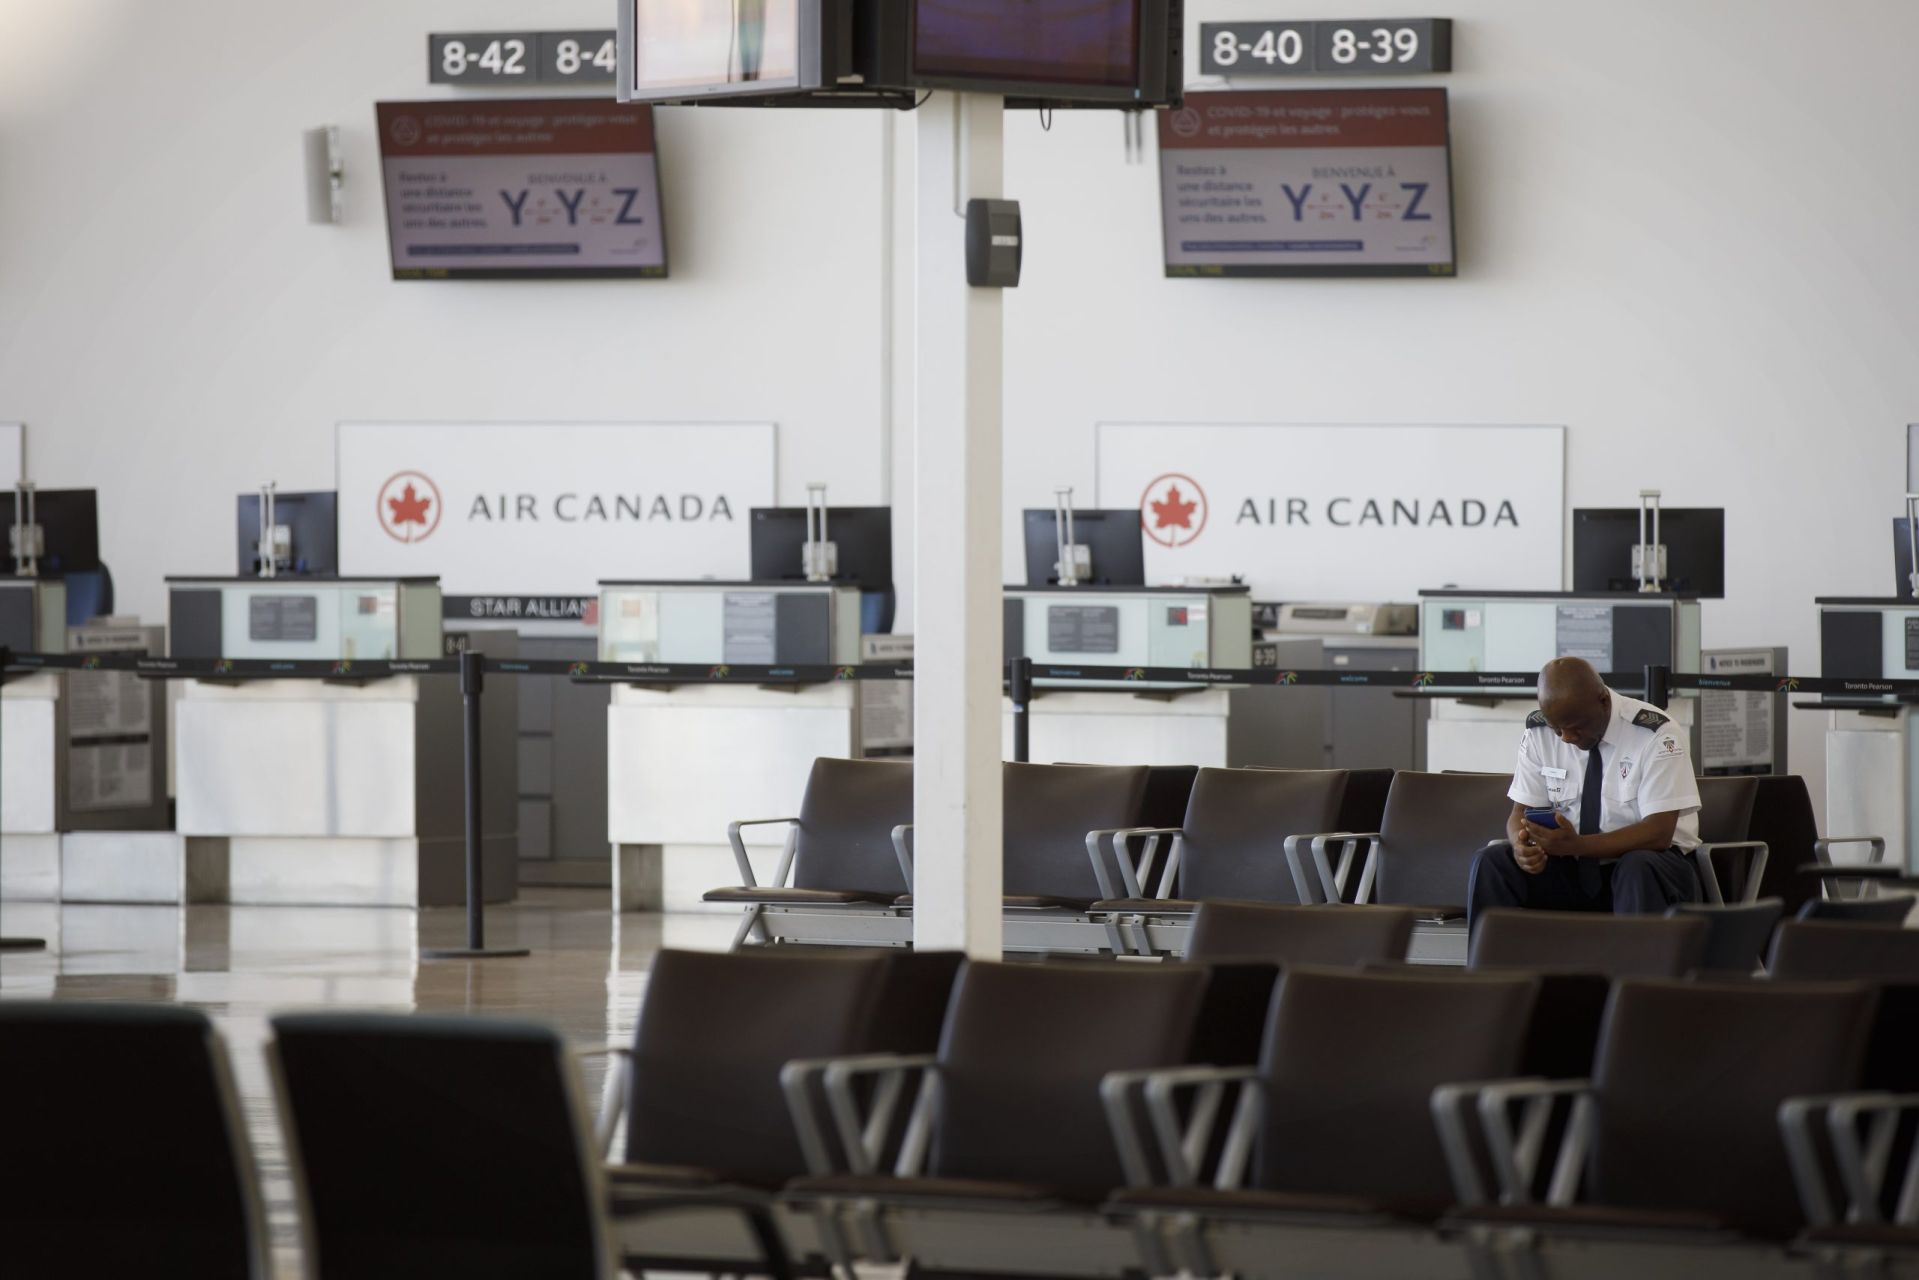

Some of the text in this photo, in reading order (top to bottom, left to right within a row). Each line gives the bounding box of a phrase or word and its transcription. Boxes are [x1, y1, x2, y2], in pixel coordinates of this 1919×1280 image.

[442, 40, 526, 76] 8-42
[556, 39, 617, 75] 8-4
[1213, 29, 1303, 66] 8-40
[1331, 28, 1419, 65] 8-39
[468, 493, 735, 523] AIR CANADA
[1236, 497, 1520, 528] AIR CANADA
[470, 598, 522, 617] STAR
[1187, 671, 1233, 681] Toronto Pearson
[1478, 675, 1525, 685] Toronto Pearson
[1845, 682, 1893, 691] Toronto Pearson
